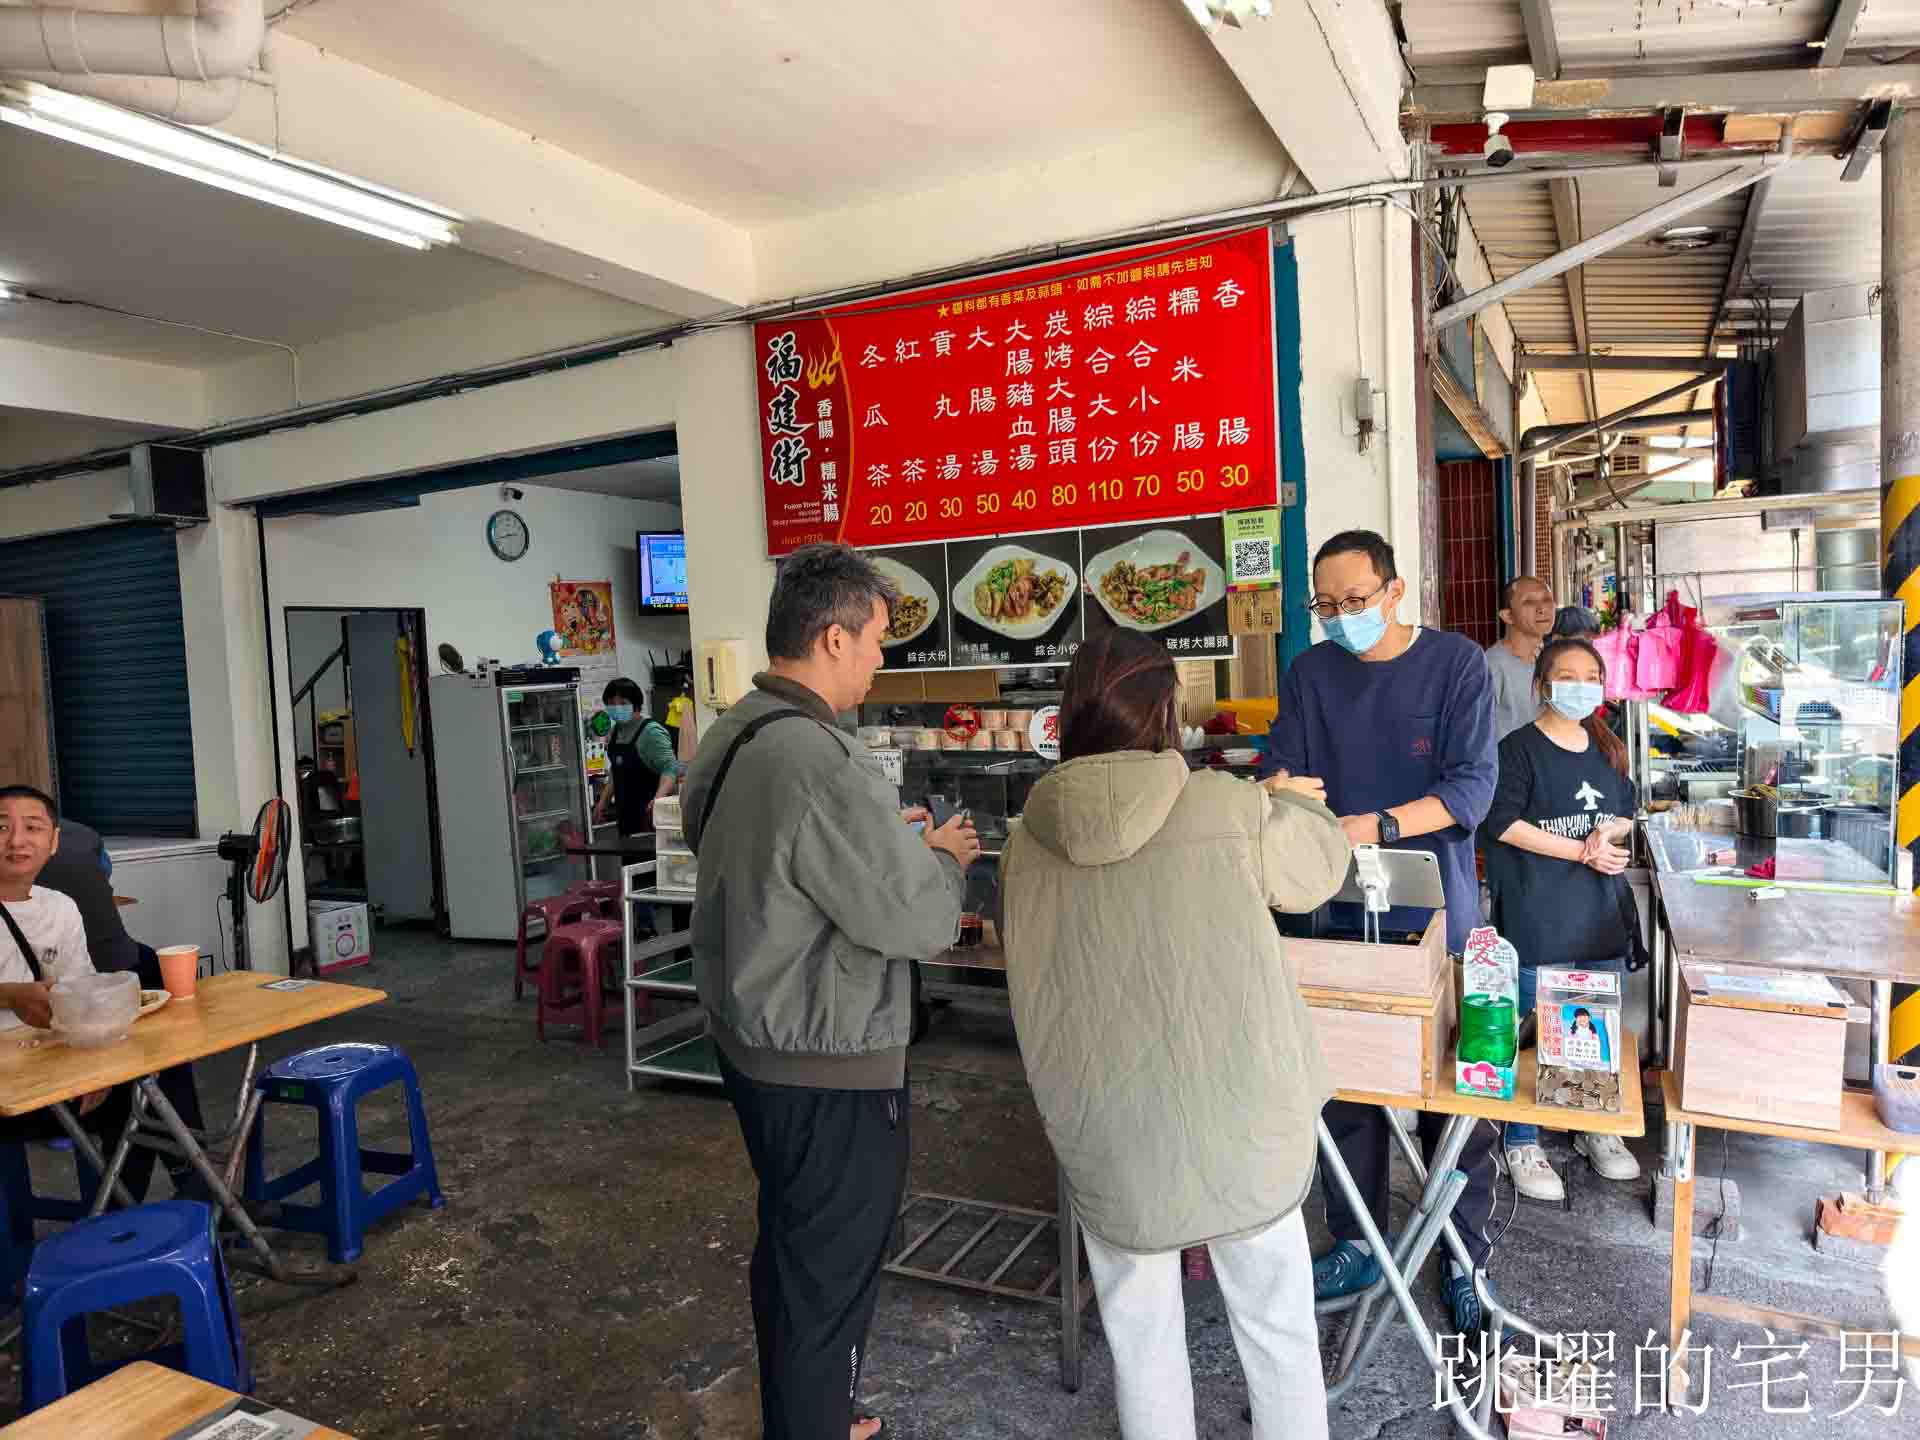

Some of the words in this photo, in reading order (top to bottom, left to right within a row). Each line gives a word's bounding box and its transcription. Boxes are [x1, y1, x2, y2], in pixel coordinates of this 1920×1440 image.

[766, 331, 815, 487] 福建街
[860, 344, 892, 487] 冬瓜茶
[896, 338, 927, 483] 紅茶
[930, 329, 963, 480] 貢丸湯
[967, 325, 1000, 477] 大腸湯
[1004, 319, 1039, 471] 大腸豬血湯
[1044, 309, 1078, 466] 炭烤大腸頭
[1083, 303, 1119, 463] 綜合大份
[1125, 296, 1161, 457] 綜合小份
[1168, 286, 1205, 452] 糯米腸
[1213, 279, 1251, 447] 香腸
[870, 504, 893, 525] 20
[904, 501, 928, 522] 20
[939, 497, 963, 518] 30
[976, 493, 1000, 514] 50
[1011, 489, 1037, 511] 40
[1051, 484, 1077, 506] 80
[1087, 479, 1123, 503] 110
[1133, 475, 1161, 497] 70
[1177, 469, 1205, 492] 50
[1220, 464, 1249, 488] 30
